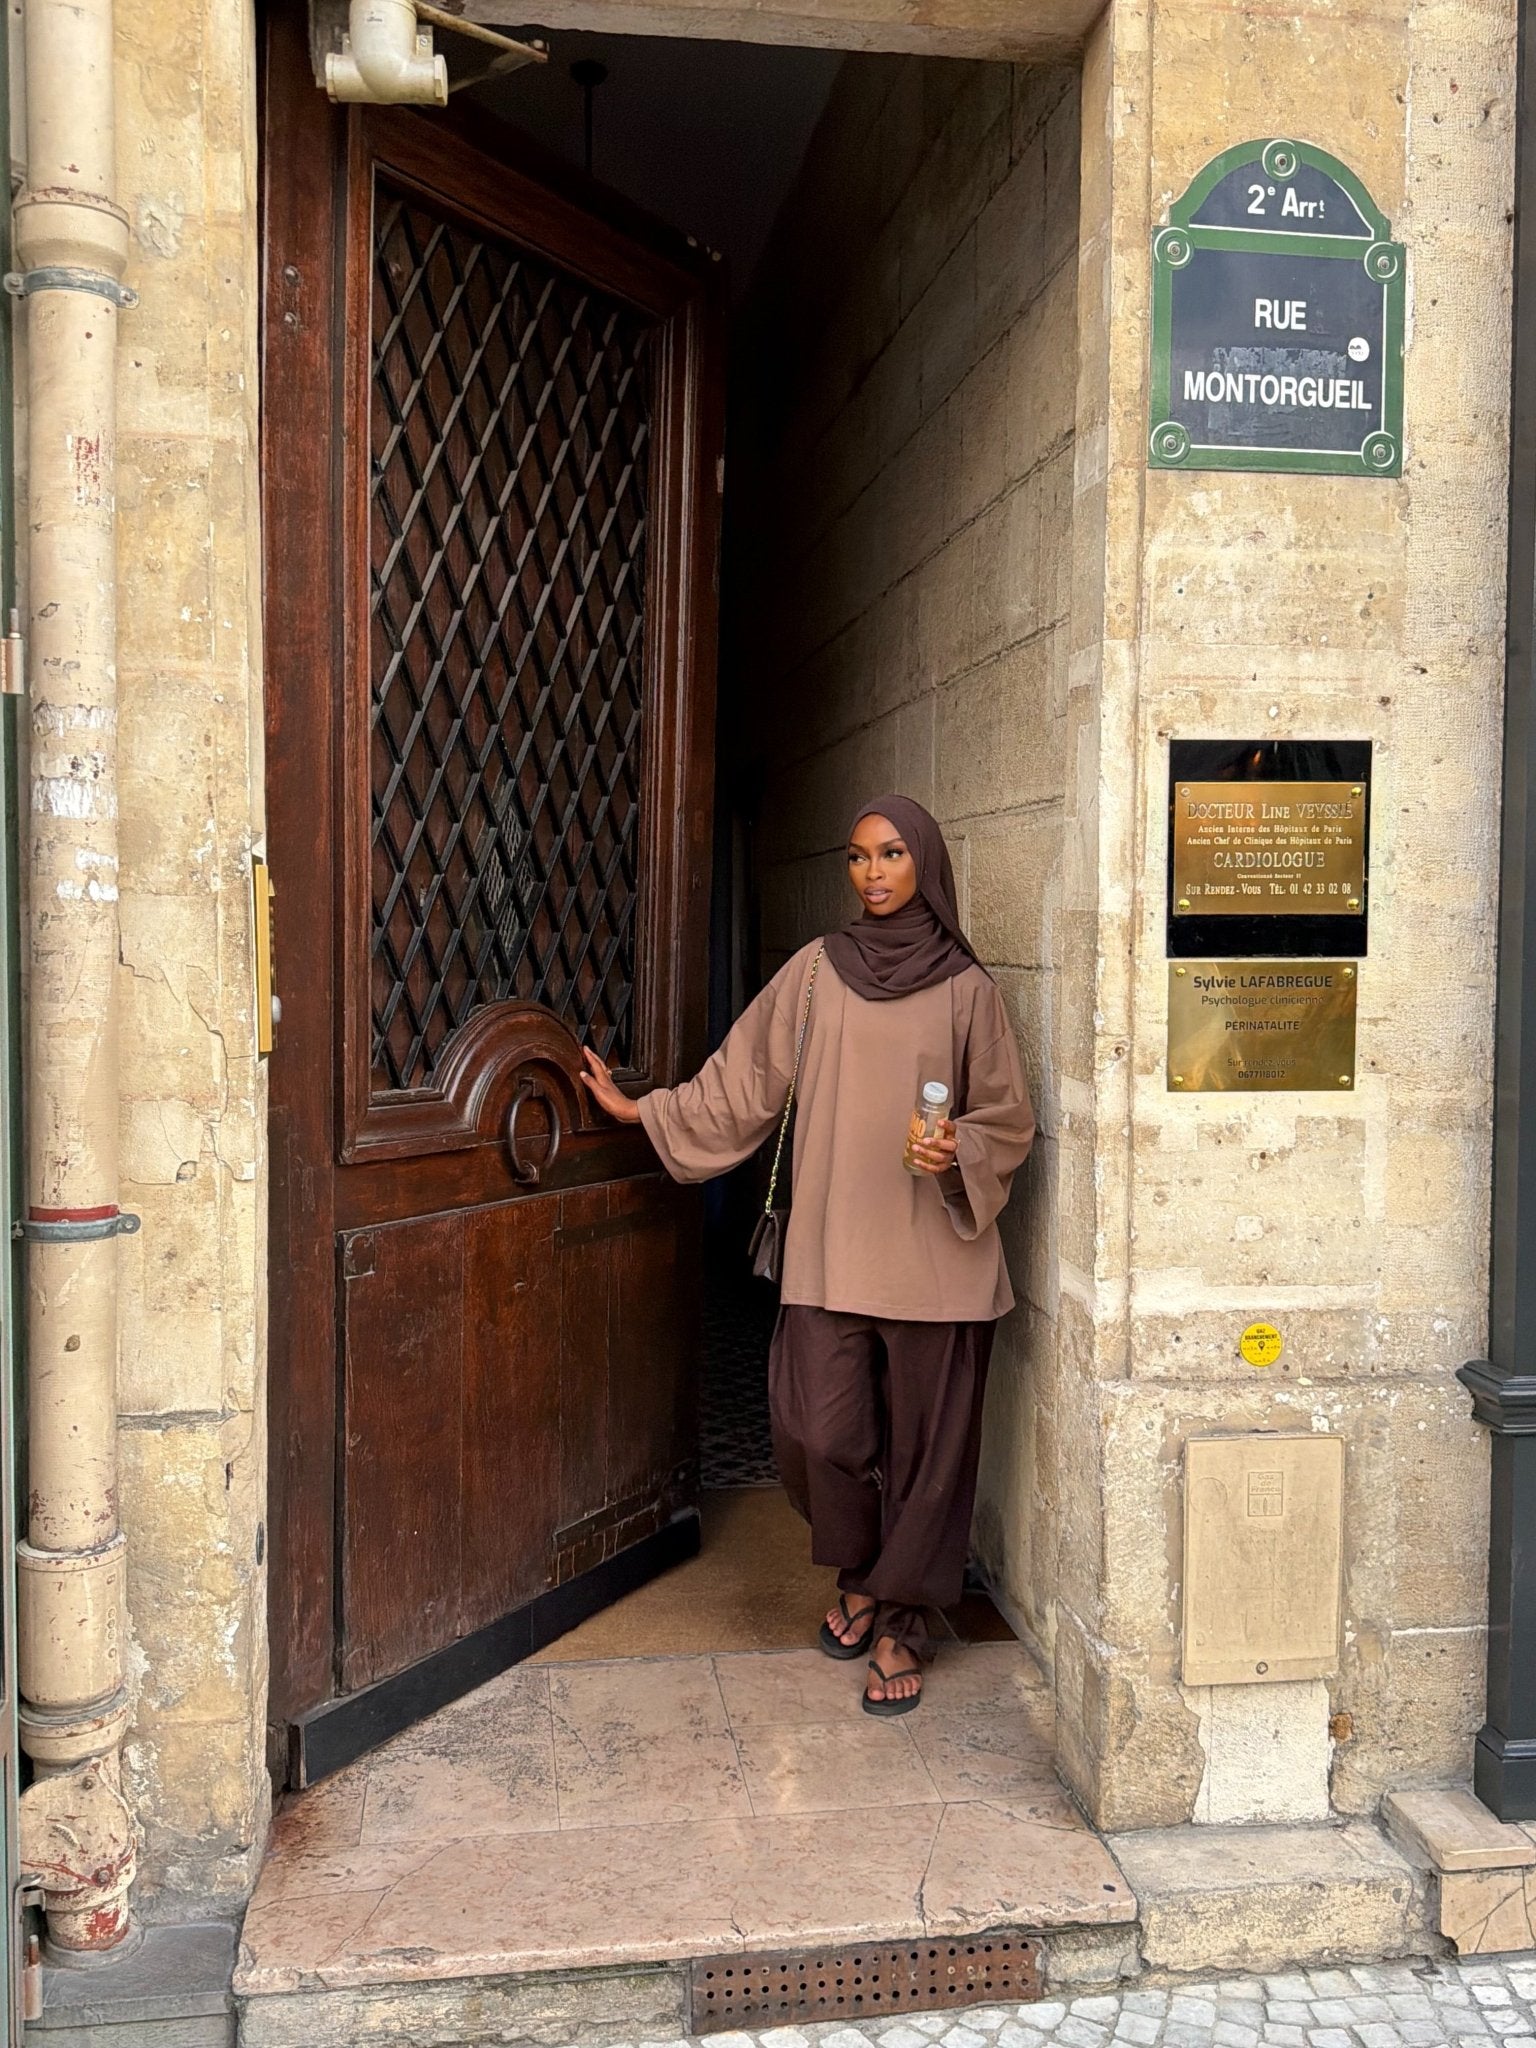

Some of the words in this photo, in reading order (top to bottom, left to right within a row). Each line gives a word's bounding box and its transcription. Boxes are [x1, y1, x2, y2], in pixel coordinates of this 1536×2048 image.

[1254, 298, 1307, 330] RUE
[1183, 370, 1373, 410] MONTORGUEIL
[1187, 803, 1255, 819] DOCTEUR
[1198, 825, 1224, 833] Ancien
[1227, 825, 1255, 833] Interne
[1258, 825, 1271, 833] des
[1274, 825, 1308, 834] Hôpitaux
[1311, 825, 1320, 833] de
[1323, 825, 1342, 833] Paris
[1187, 837, 1211, 845] Ancien
[1213, 837, 1231, 845] Chef
[1232, 837, 1242, 845] de
[1243, 837, 1273, 846] Clinique
[1275, 837, 1287, 845] des
[1323, 837, 1333, 845] de
[1335, 837, 1353, 845] Paris
[1213, 852, 1326, 868] CARDIOLOGUE
[1289, 882, 1299, 895] 01
[1302, 882, 1313, 895] 42
[1315, 882, 1326, 895] 33
[1328, 882, 1339, 895] 02
[1341, 882, 1352, 895] 08
[1193, 976, 1236, 991] Sylvie
[1240, 975, 1334, 988] LAFABREGUE
[1201, 995, 1267, 1007] Psychologue
